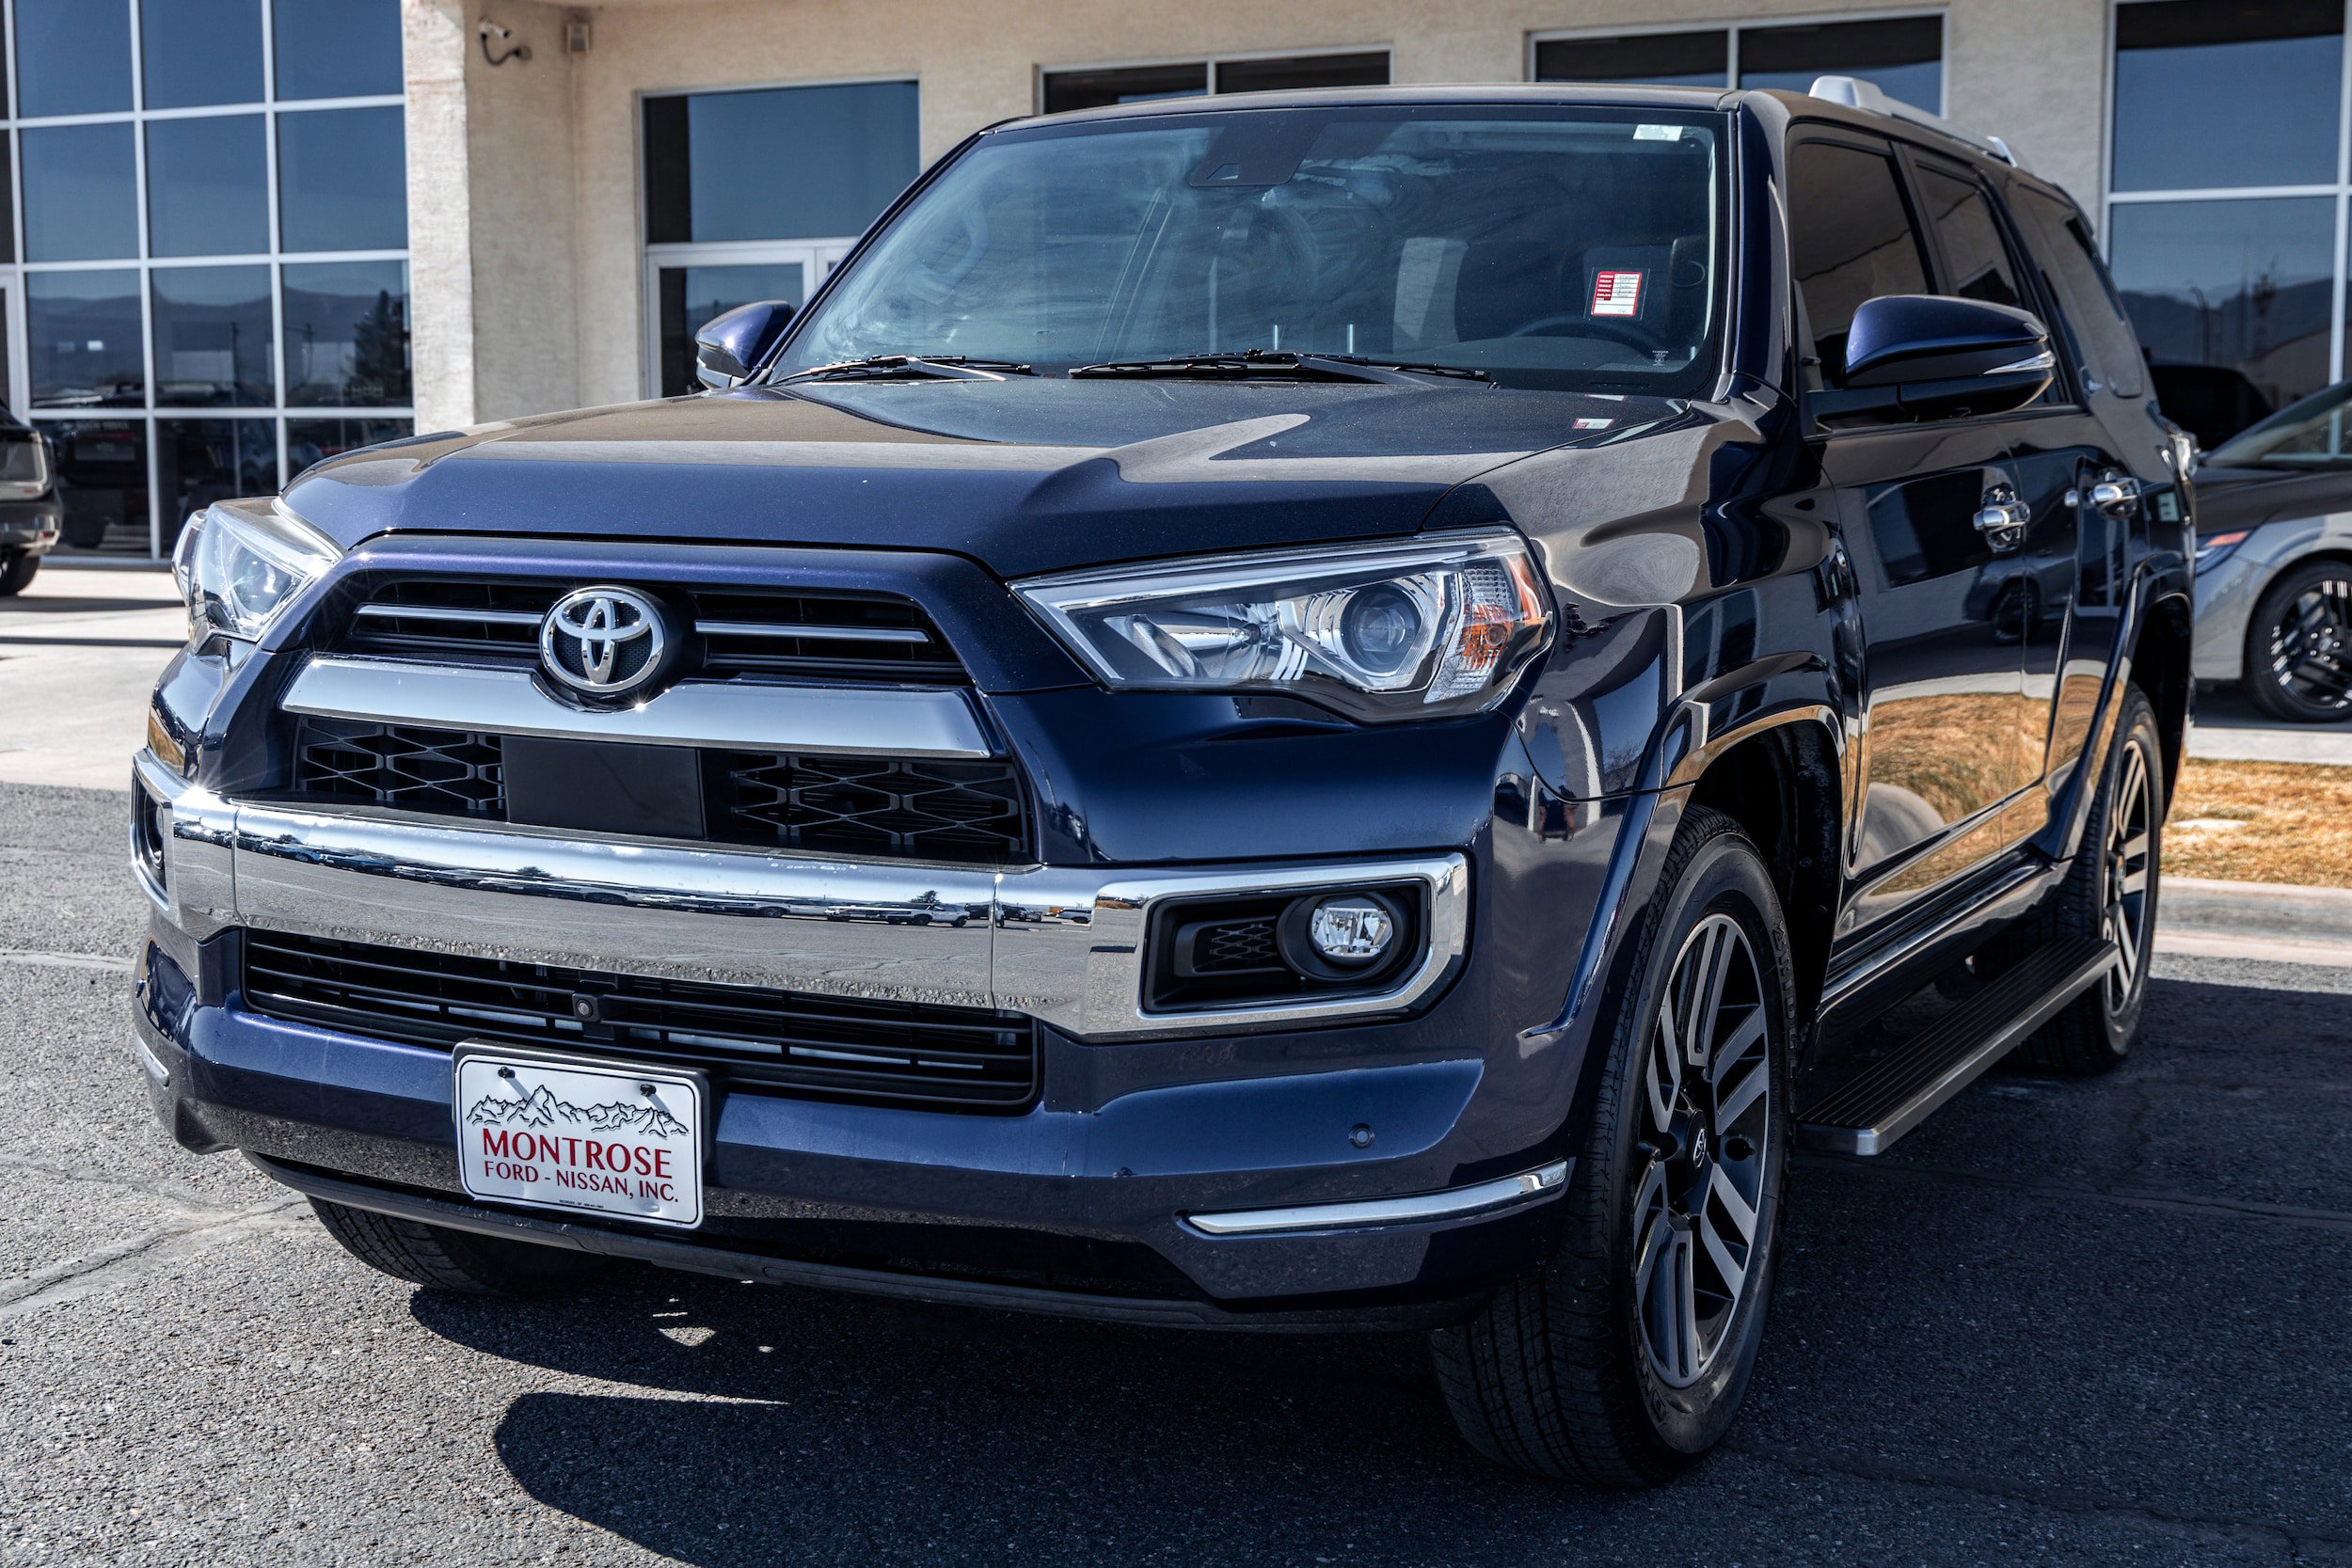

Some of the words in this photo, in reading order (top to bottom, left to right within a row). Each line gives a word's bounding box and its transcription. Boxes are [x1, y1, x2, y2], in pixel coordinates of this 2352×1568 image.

[483, 1128, 673, 1180] MONTROSE
[485, 1161, 539, 1183] FORD
[556, 1169, 634, 1200] NISSAN,
[639, 1180, 679, 1204] INC.
